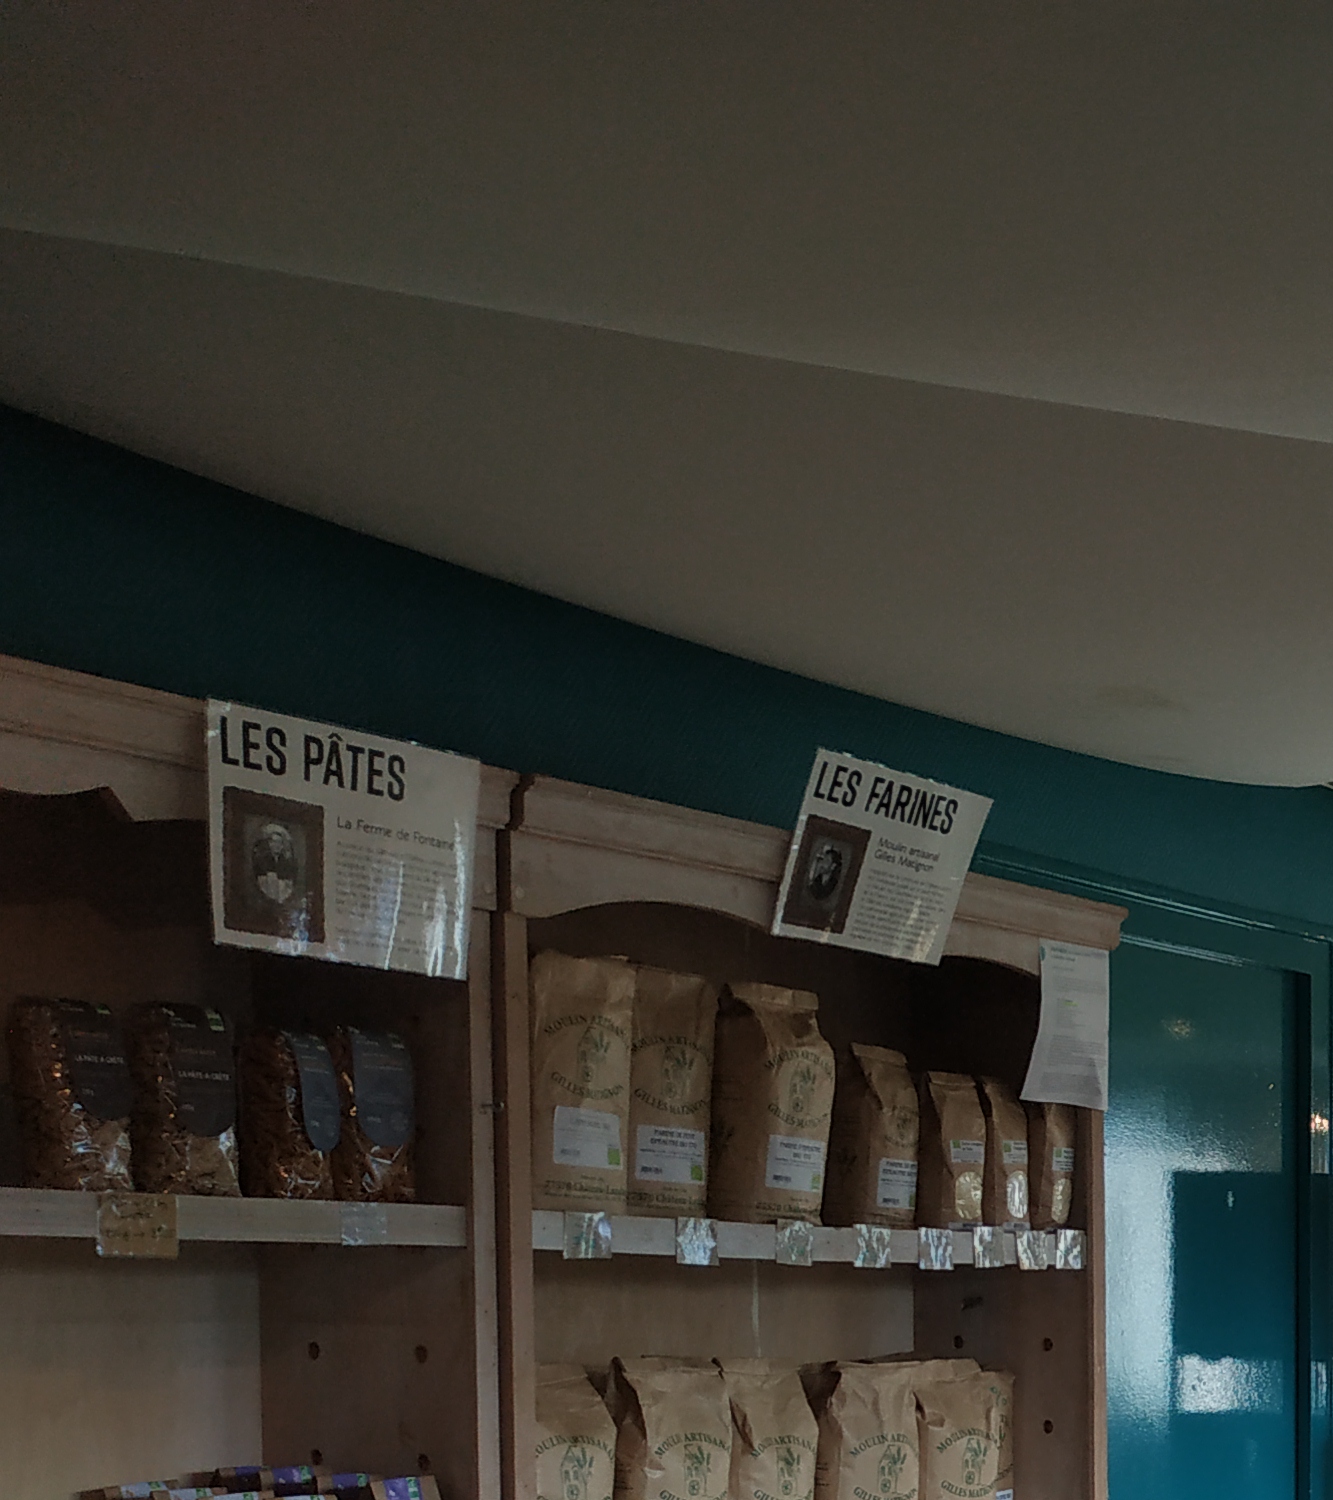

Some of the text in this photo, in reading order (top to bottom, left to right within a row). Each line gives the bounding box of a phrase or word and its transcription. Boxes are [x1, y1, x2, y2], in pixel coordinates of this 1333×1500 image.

[219, 715, 406, 801] LES PÂTES
[813, 761, 959, 835] LES FARINES
[337, 815, 353, 831] La
[356, 819, 393, 841] Ferme
[396, 824, 411, 842] de
[877, 836, 908, 855] Moulin
[873, 849, 935, 873] Gilles Matignon
[535, 1433, 567, 1459] OULIN
[940, 1479, 968, 1498] GILLES
